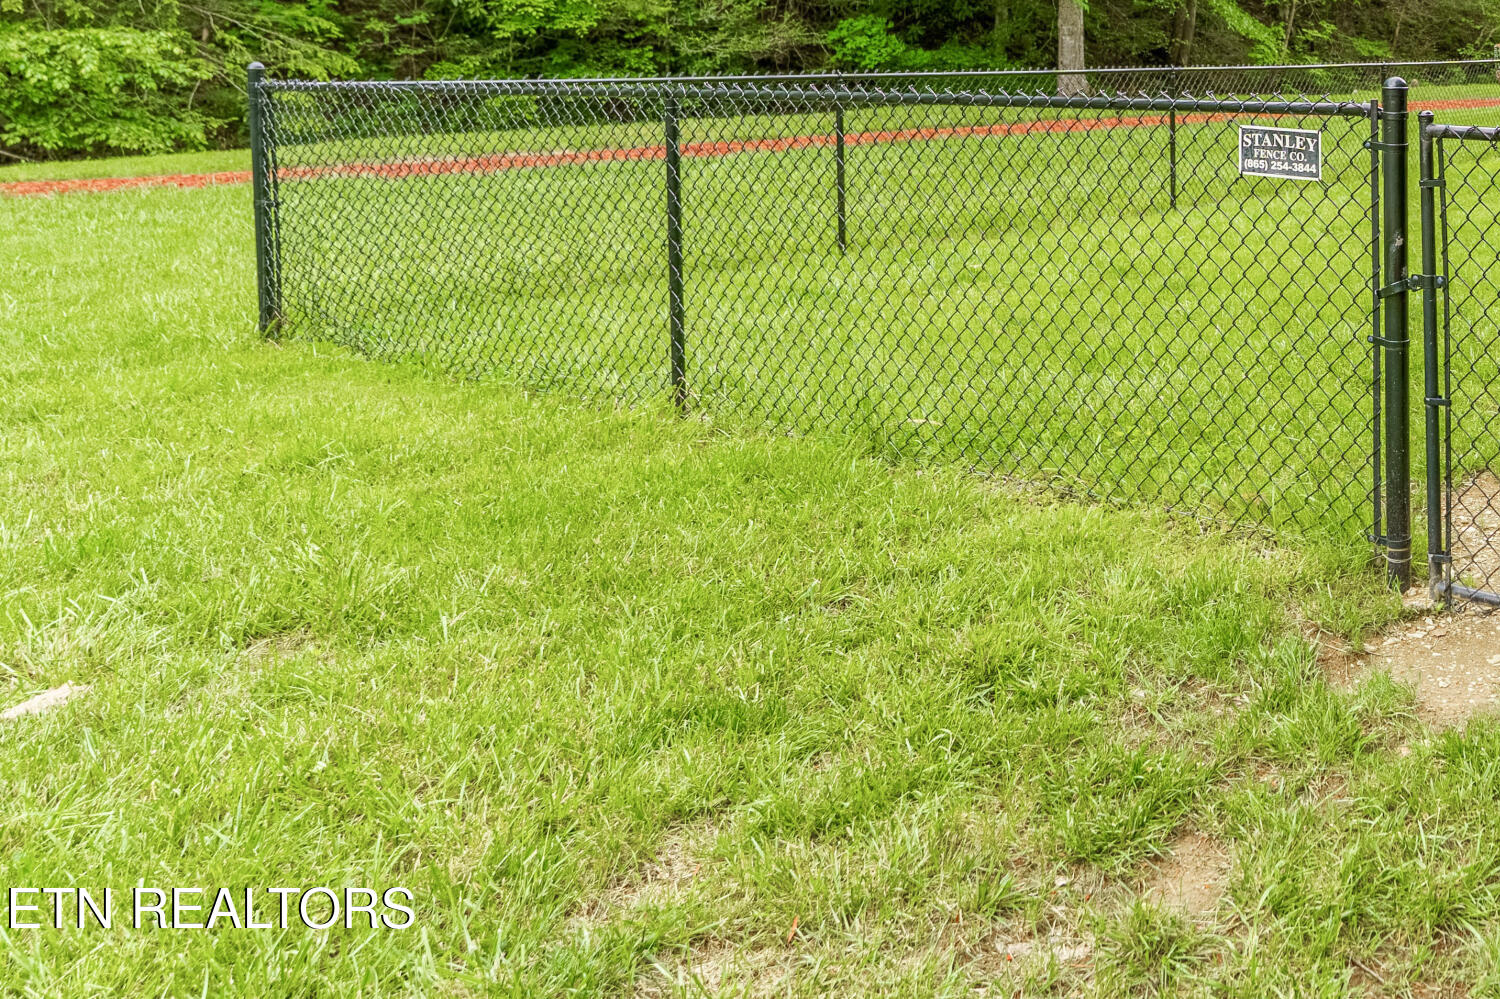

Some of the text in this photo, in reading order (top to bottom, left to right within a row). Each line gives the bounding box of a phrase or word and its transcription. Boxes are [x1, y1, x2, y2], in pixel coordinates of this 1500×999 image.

[1242, 133, 1318, 152] STANLEY
[1253, 148, 1308, 162] FENCE CO.
[1244, 158, 1317, 173] (865) 254-3844
